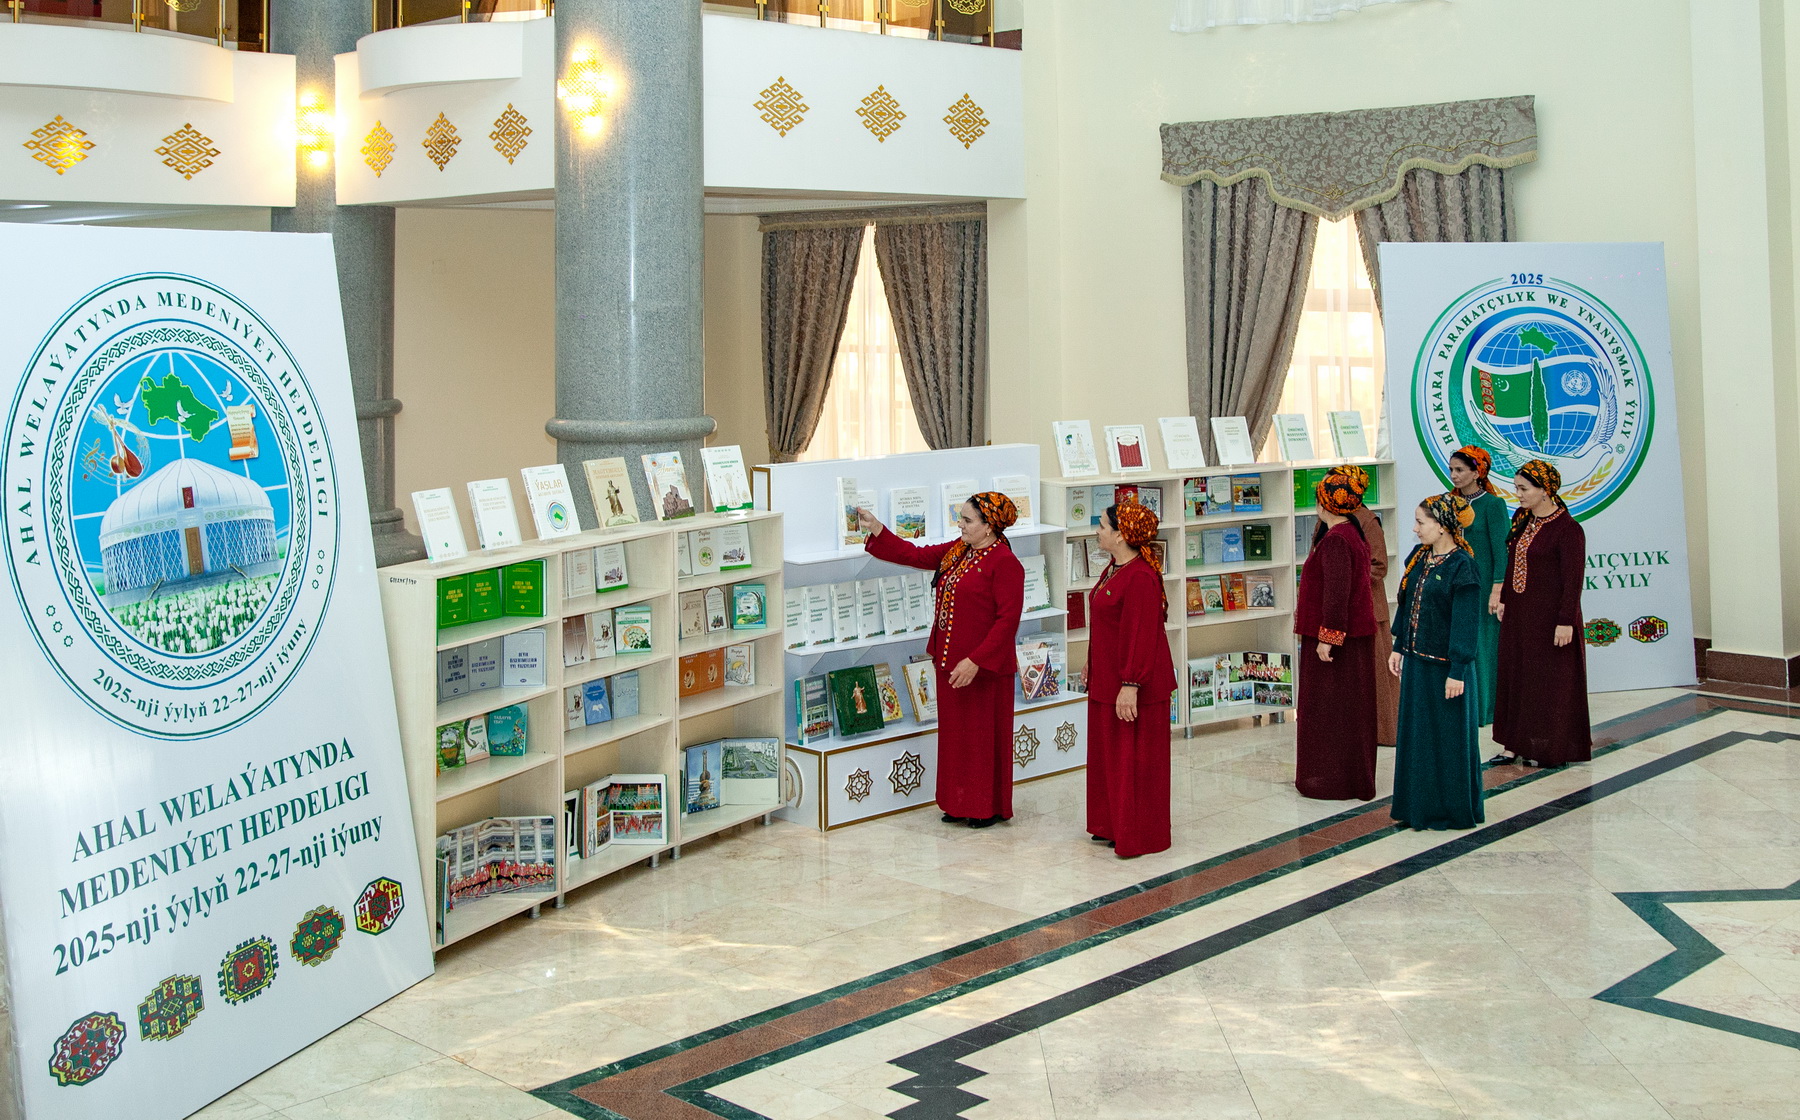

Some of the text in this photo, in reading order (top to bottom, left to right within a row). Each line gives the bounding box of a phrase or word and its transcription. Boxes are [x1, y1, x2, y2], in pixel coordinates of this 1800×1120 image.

[1510, 273, 1543, 285] 2025
[1431, 291, 1638, 446] HALKARA PARAHATÇYLYK WE YNANYŞMAK ÝYLY
[17, 291, 328, 566] AHAL WELAÝATYNDA MEDENIÝET HEPDELIGI
[535, 479, 563, 491] ÝAŞLAR
[1584, 550, 1670, 571] ATÇYLYK
[1603, 570, 1652, 589] ÝYLY
[92, 668, 160, 718] 2025-nji
[163, 701, 208, 723] ýylyň
[276, 619, 307, 666] iýuny
[58, 770, 370, 919] MEDENIÝET HEPDELIGI
[72, 737, 355, 863] AHAL WELAÝATYNDA
[53, 816, 382, 976] 2025-nji ýylyň 22-27-nji iýuny
